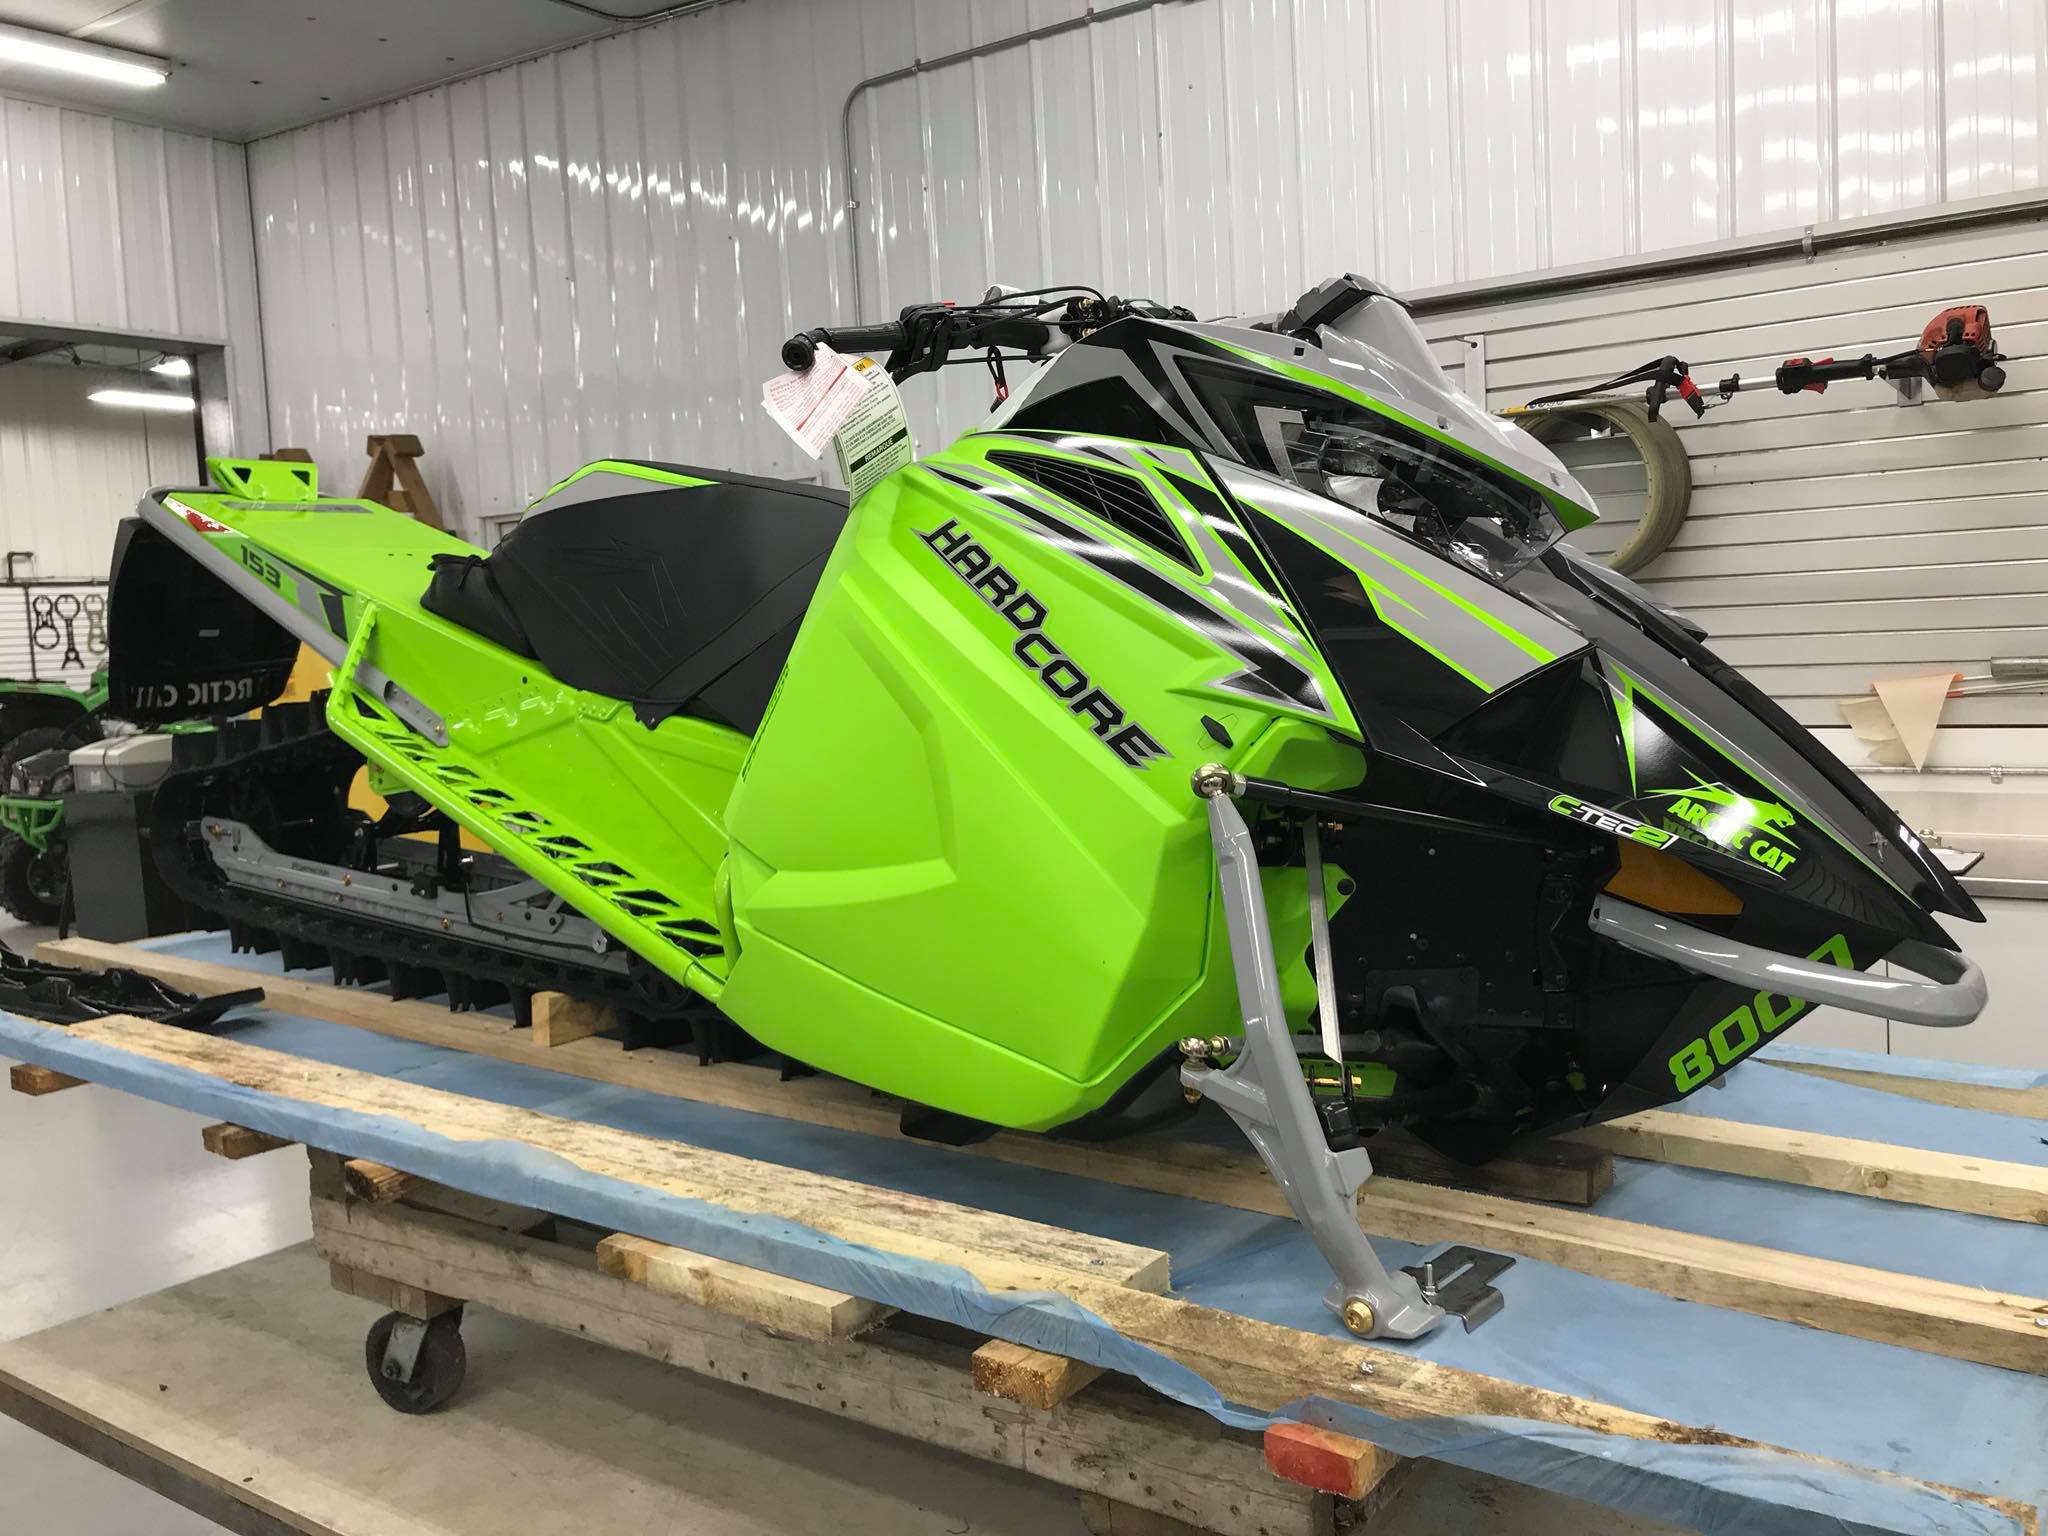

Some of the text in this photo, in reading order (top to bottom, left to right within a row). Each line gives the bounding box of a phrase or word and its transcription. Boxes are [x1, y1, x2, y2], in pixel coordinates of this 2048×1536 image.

[864, 438, 894, 462] REMARQUE
[241, 544, 281, 589] 153
[1551, 796, 1671, 849] C-TEC2
[1667, 797, 1796, 873] ARCC CAT
